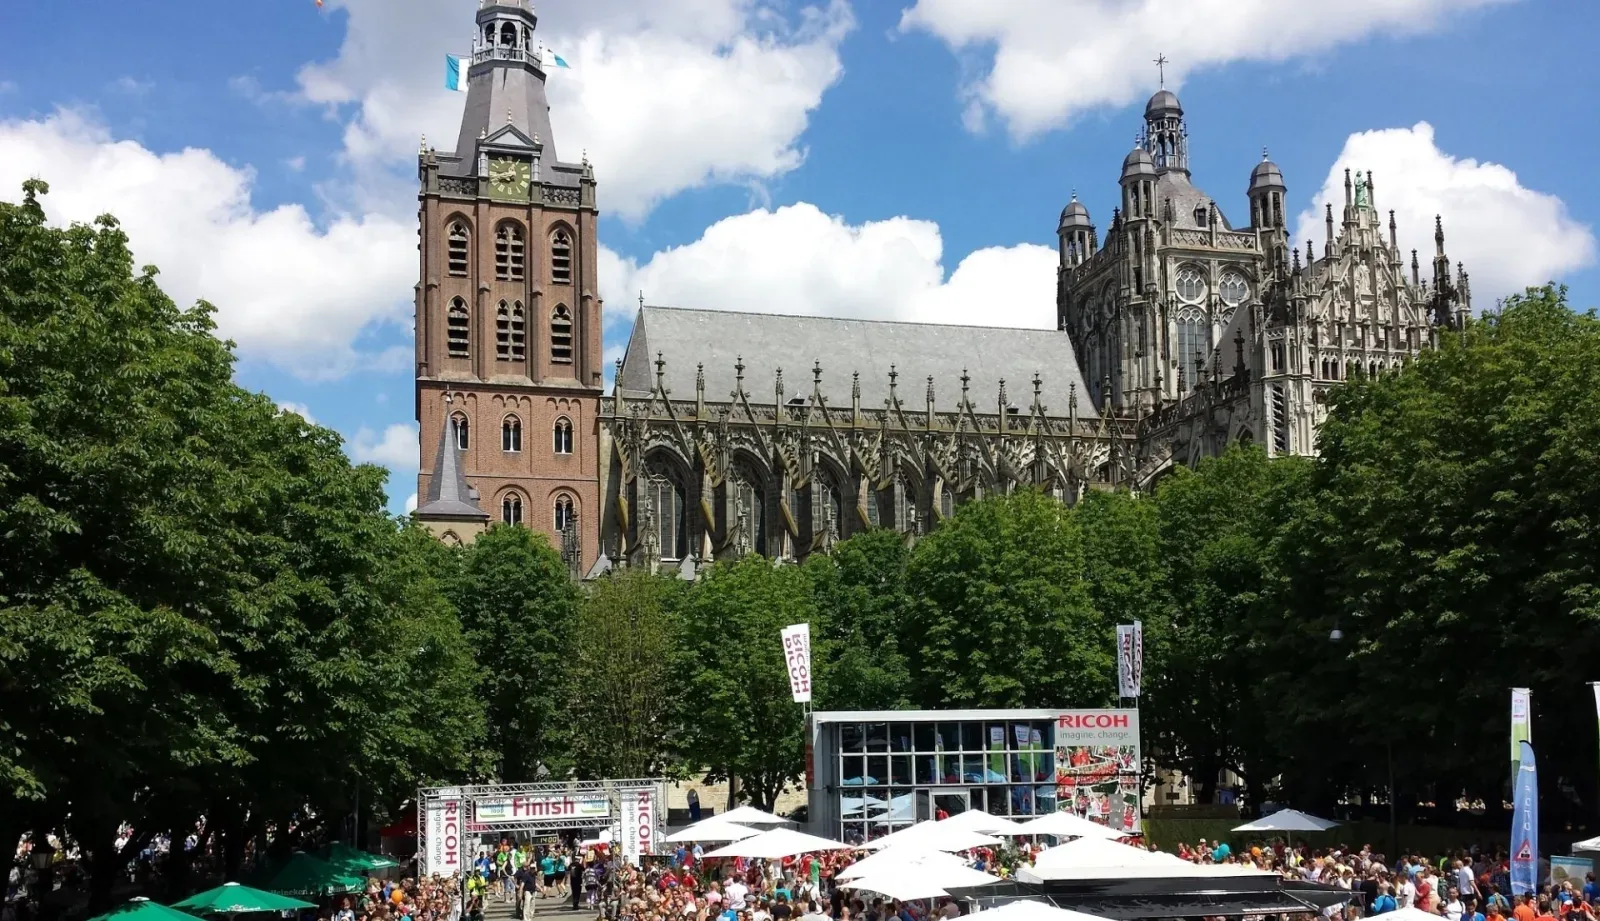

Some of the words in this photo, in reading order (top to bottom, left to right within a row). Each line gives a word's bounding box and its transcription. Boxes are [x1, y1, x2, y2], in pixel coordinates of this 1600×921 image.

[1060, 715, 1128, 728] RICOH
[1060, 731, 1095, 740] imagine.
[1098, 731, 1131, 740] change.
[513, 795, 574, 816] Finish
[445, 801, 457, 864] RICOH
[638, 792, 650, 854] RICOH
